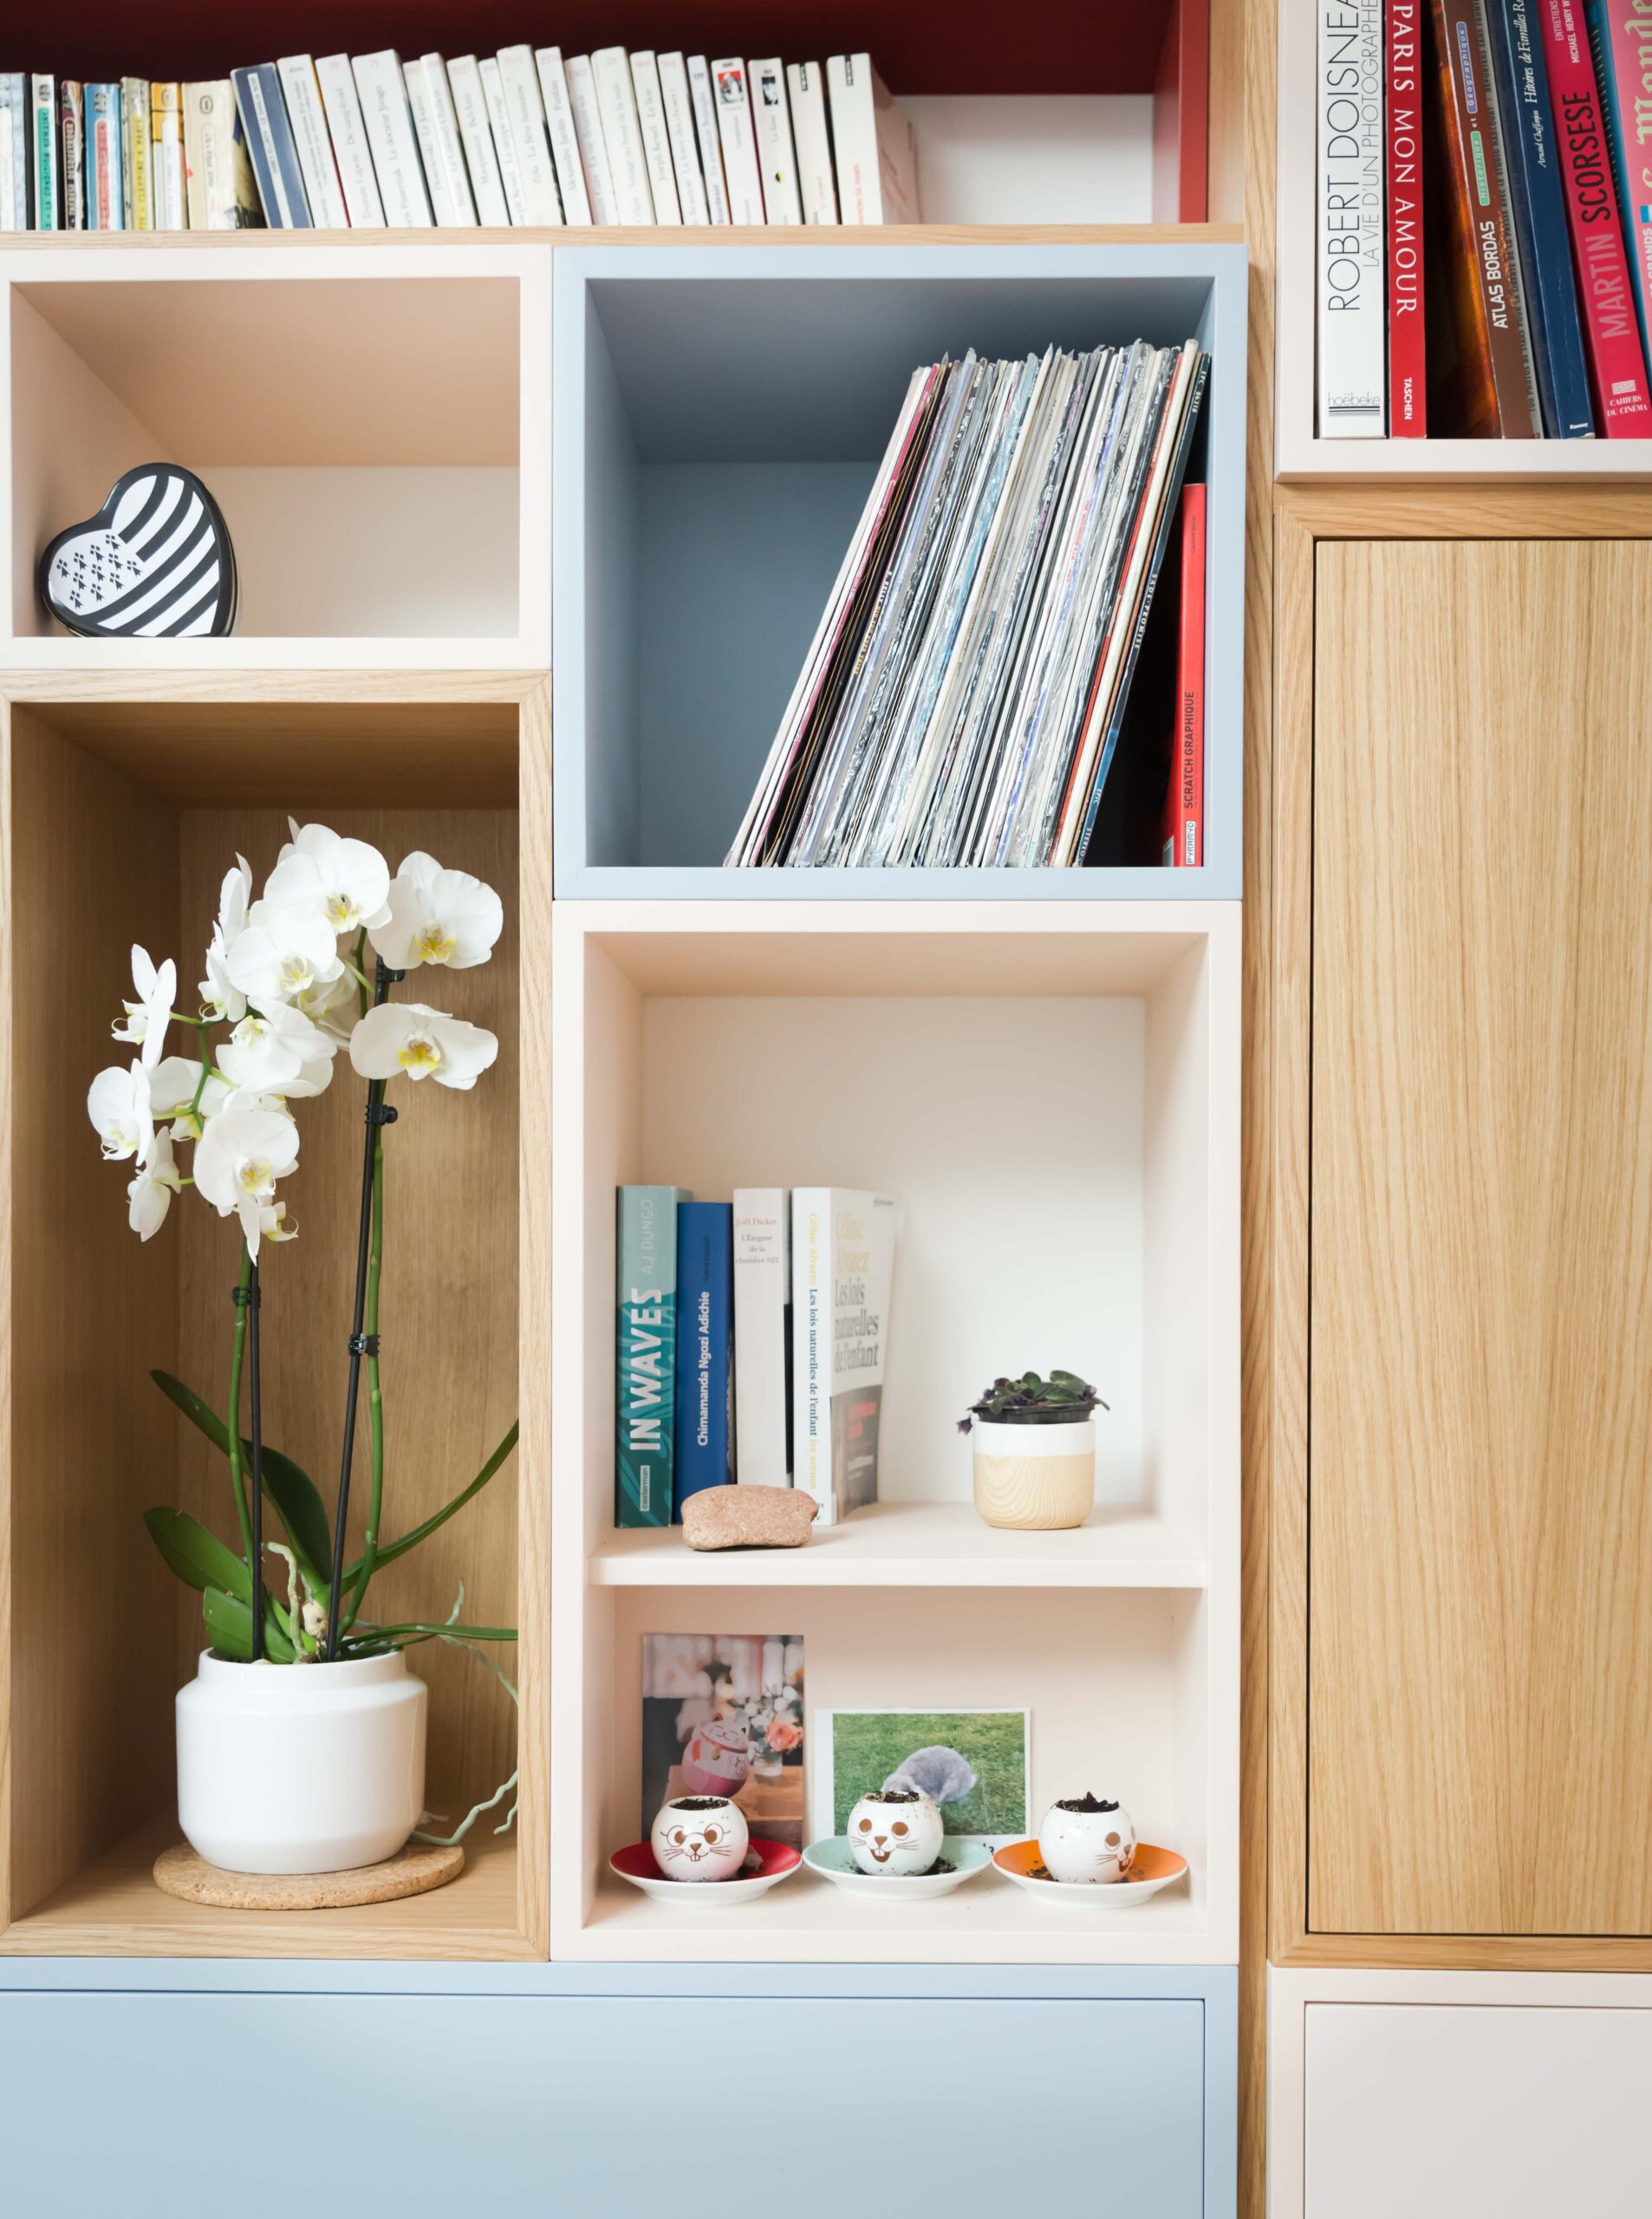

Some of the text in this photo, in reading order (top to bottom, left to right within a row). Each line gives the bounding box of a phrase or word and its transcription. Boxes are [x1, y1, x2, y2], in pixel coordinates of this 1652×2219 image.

[1512, 12, 1531, 53] Familles
[1562, 8, 1575, 31] HENRY
[1518, 51, 1532, 64] de
[1565, 32, 1580, 63] MICHAEL
[1326, 0, 1359, 309] ROBERT DOISNE
[1361, 0, 1379, 266] LA VIE D'UN PHOTOGRAPHE
[1534, 140, 1546, 168] Arnaud
[1394, 4, 1416, 316] PARIS MON AMOUR
[1457, 29, 1509, 330] ATLAS BORDAS Historique et Géographique
[1560, 89, 1630, 338] MARTIN SCORSESE
[1190, 369, 1206, 413] EPC 86318
[1328, 390, 1380, 406] hoëbeke
[1403, 377, 1413, 420] TASCHEN
[1606, 403, 1649, 417] DU CINÉMA
[1610, 394, 1642, 407] CAHIERS
[1133, 604, 1150, 649] PROMISE
[1184, 691, 1193, 808] SCRATCH GRAPHIQUE
[1079, 787, 1102, 856] EPIC STEREO
[640, 1199, 655, 1250] DUNGO
[752, 1217, 777, 1226] Dicker
[849, 1277, 866, 1306] lois
[809, 1213, 818, 1435] Céline Alvarez Les lois naturelles de l'enfant
[835, 1308, 880, 1340] naturelles
[628, 1287, 662, 1450] IN WAVES
[697, 1291, 711, 1445] Chimamanda Ngozi Adichie
[640, 1467, 648, 1509] casterman
